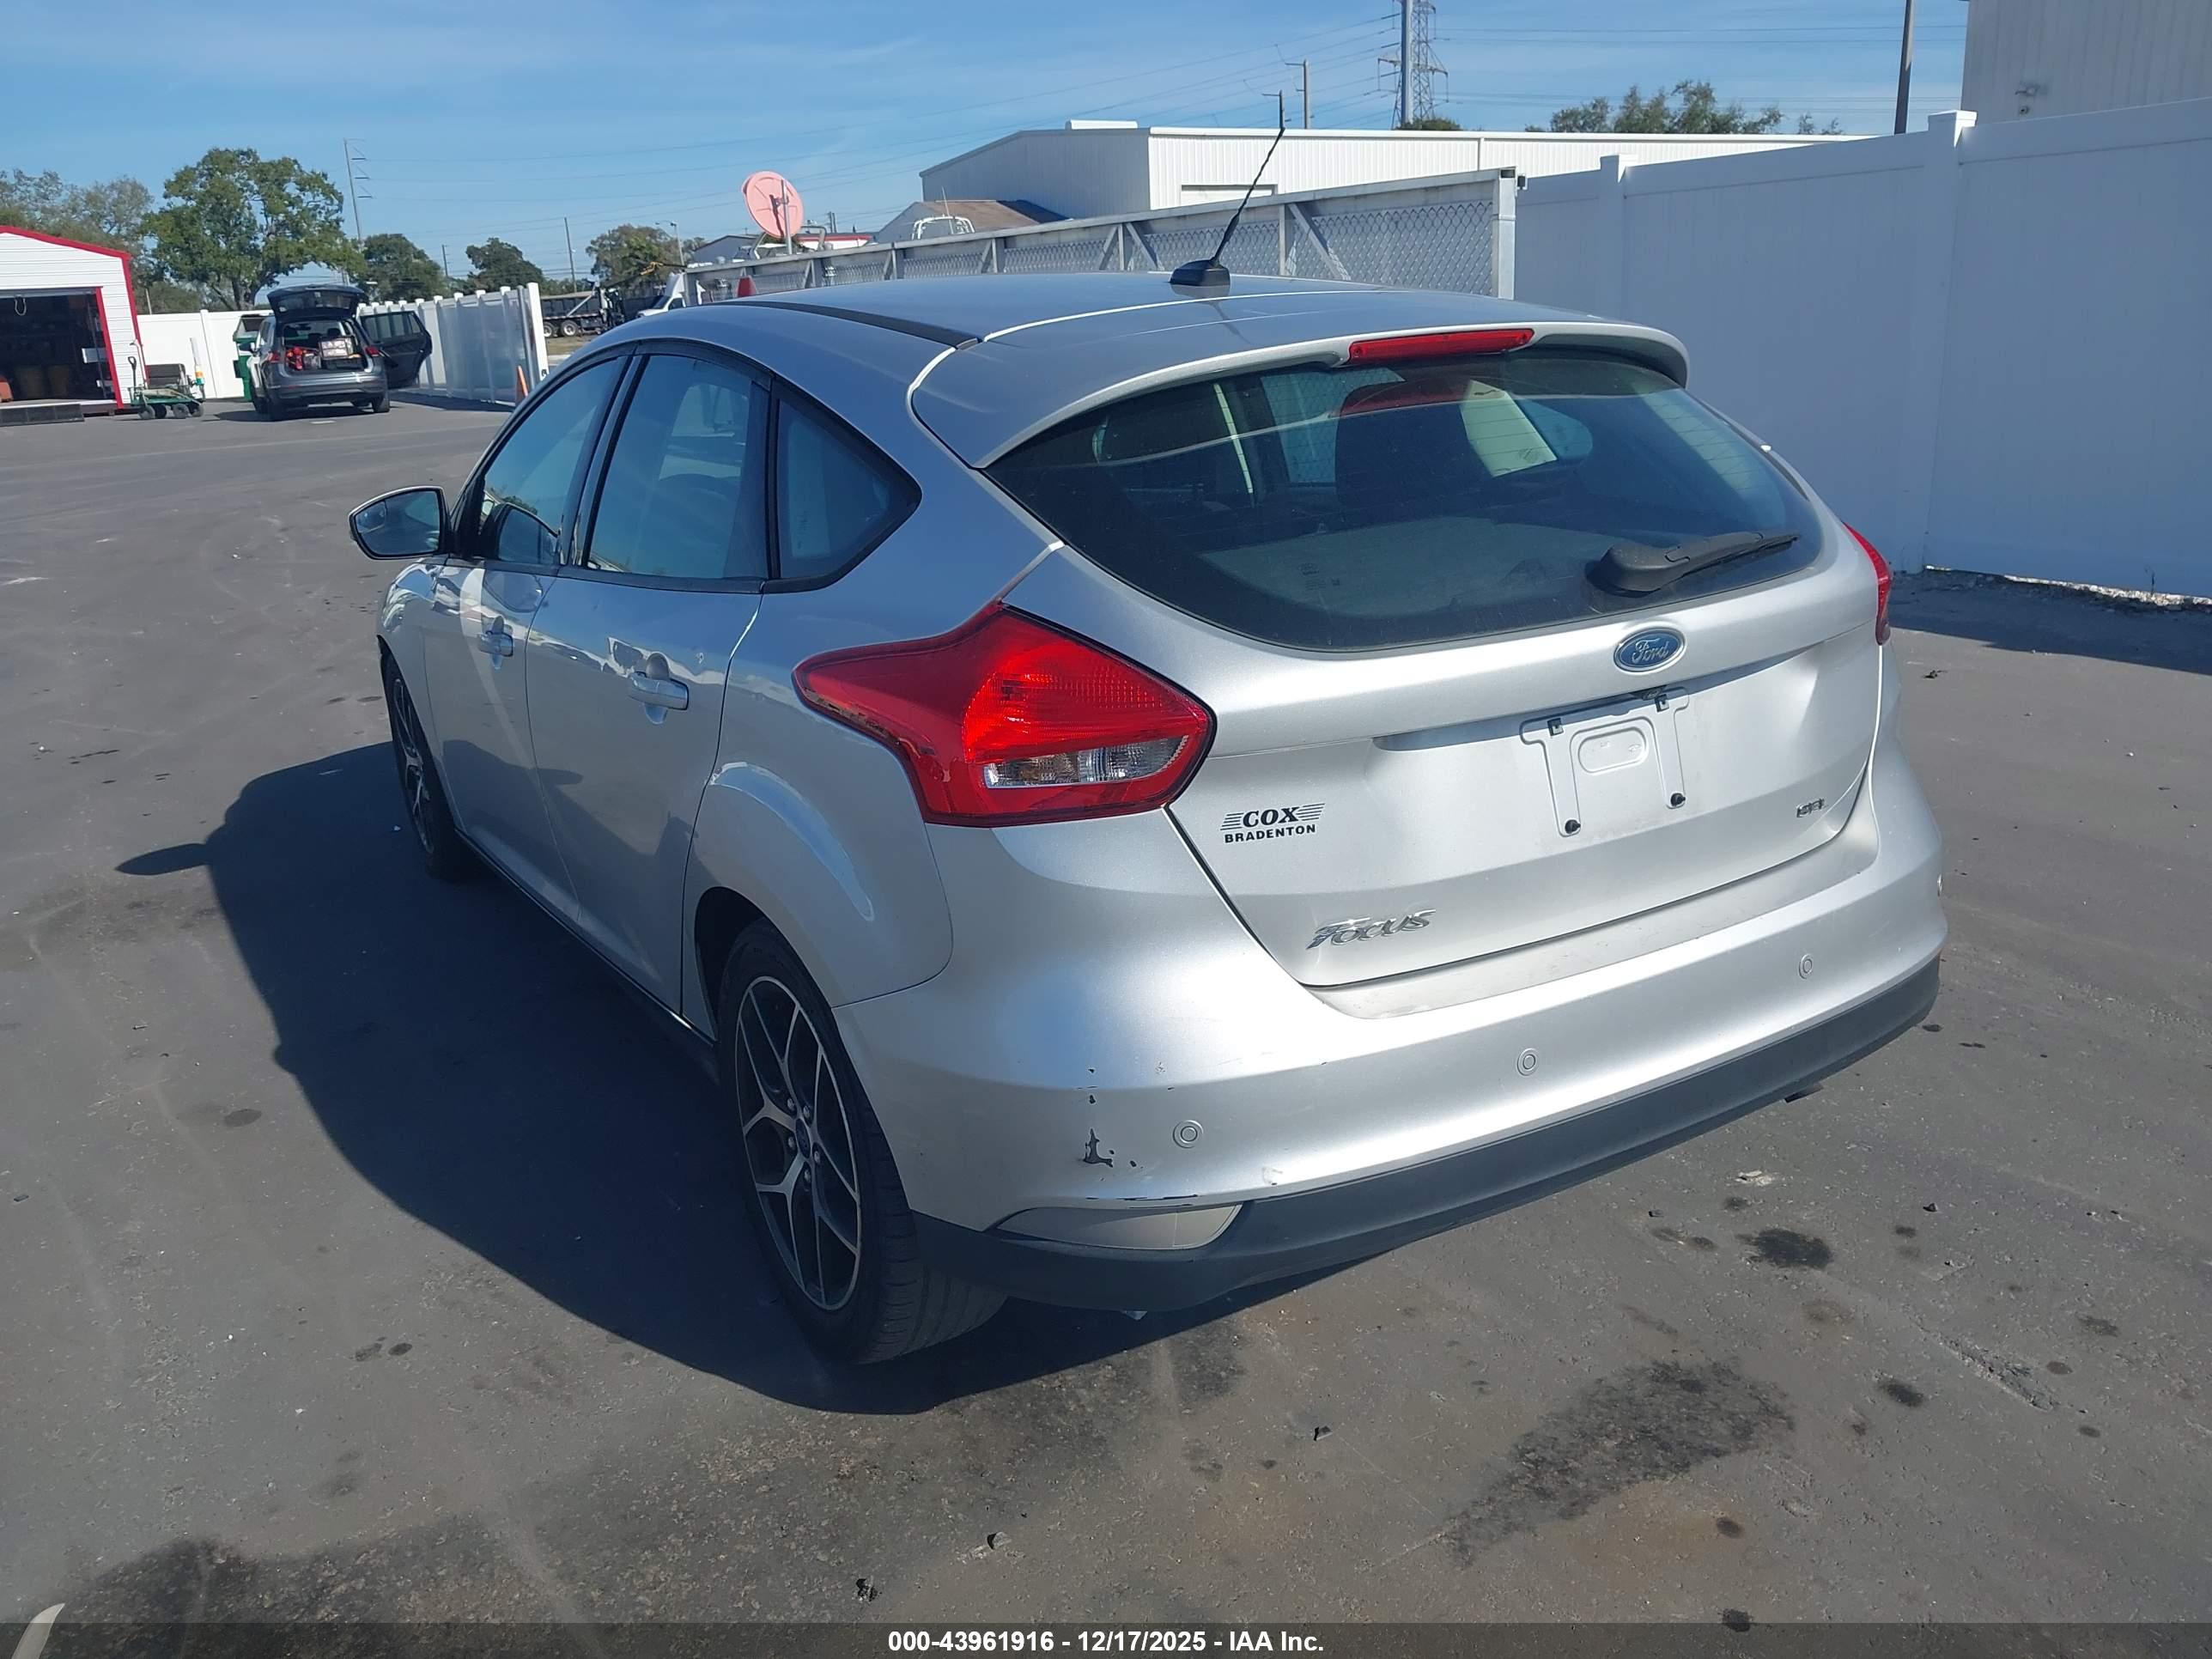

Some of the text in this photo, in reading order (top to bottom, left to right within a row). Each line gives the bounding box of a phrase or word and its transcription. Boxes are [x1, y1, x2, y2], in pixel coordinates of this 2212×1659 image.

[1632, 637, 1670, 664] Ford
[1242, 806, 1300, 828] COX
[1224, 823, 1316, 843] BRADENTON
